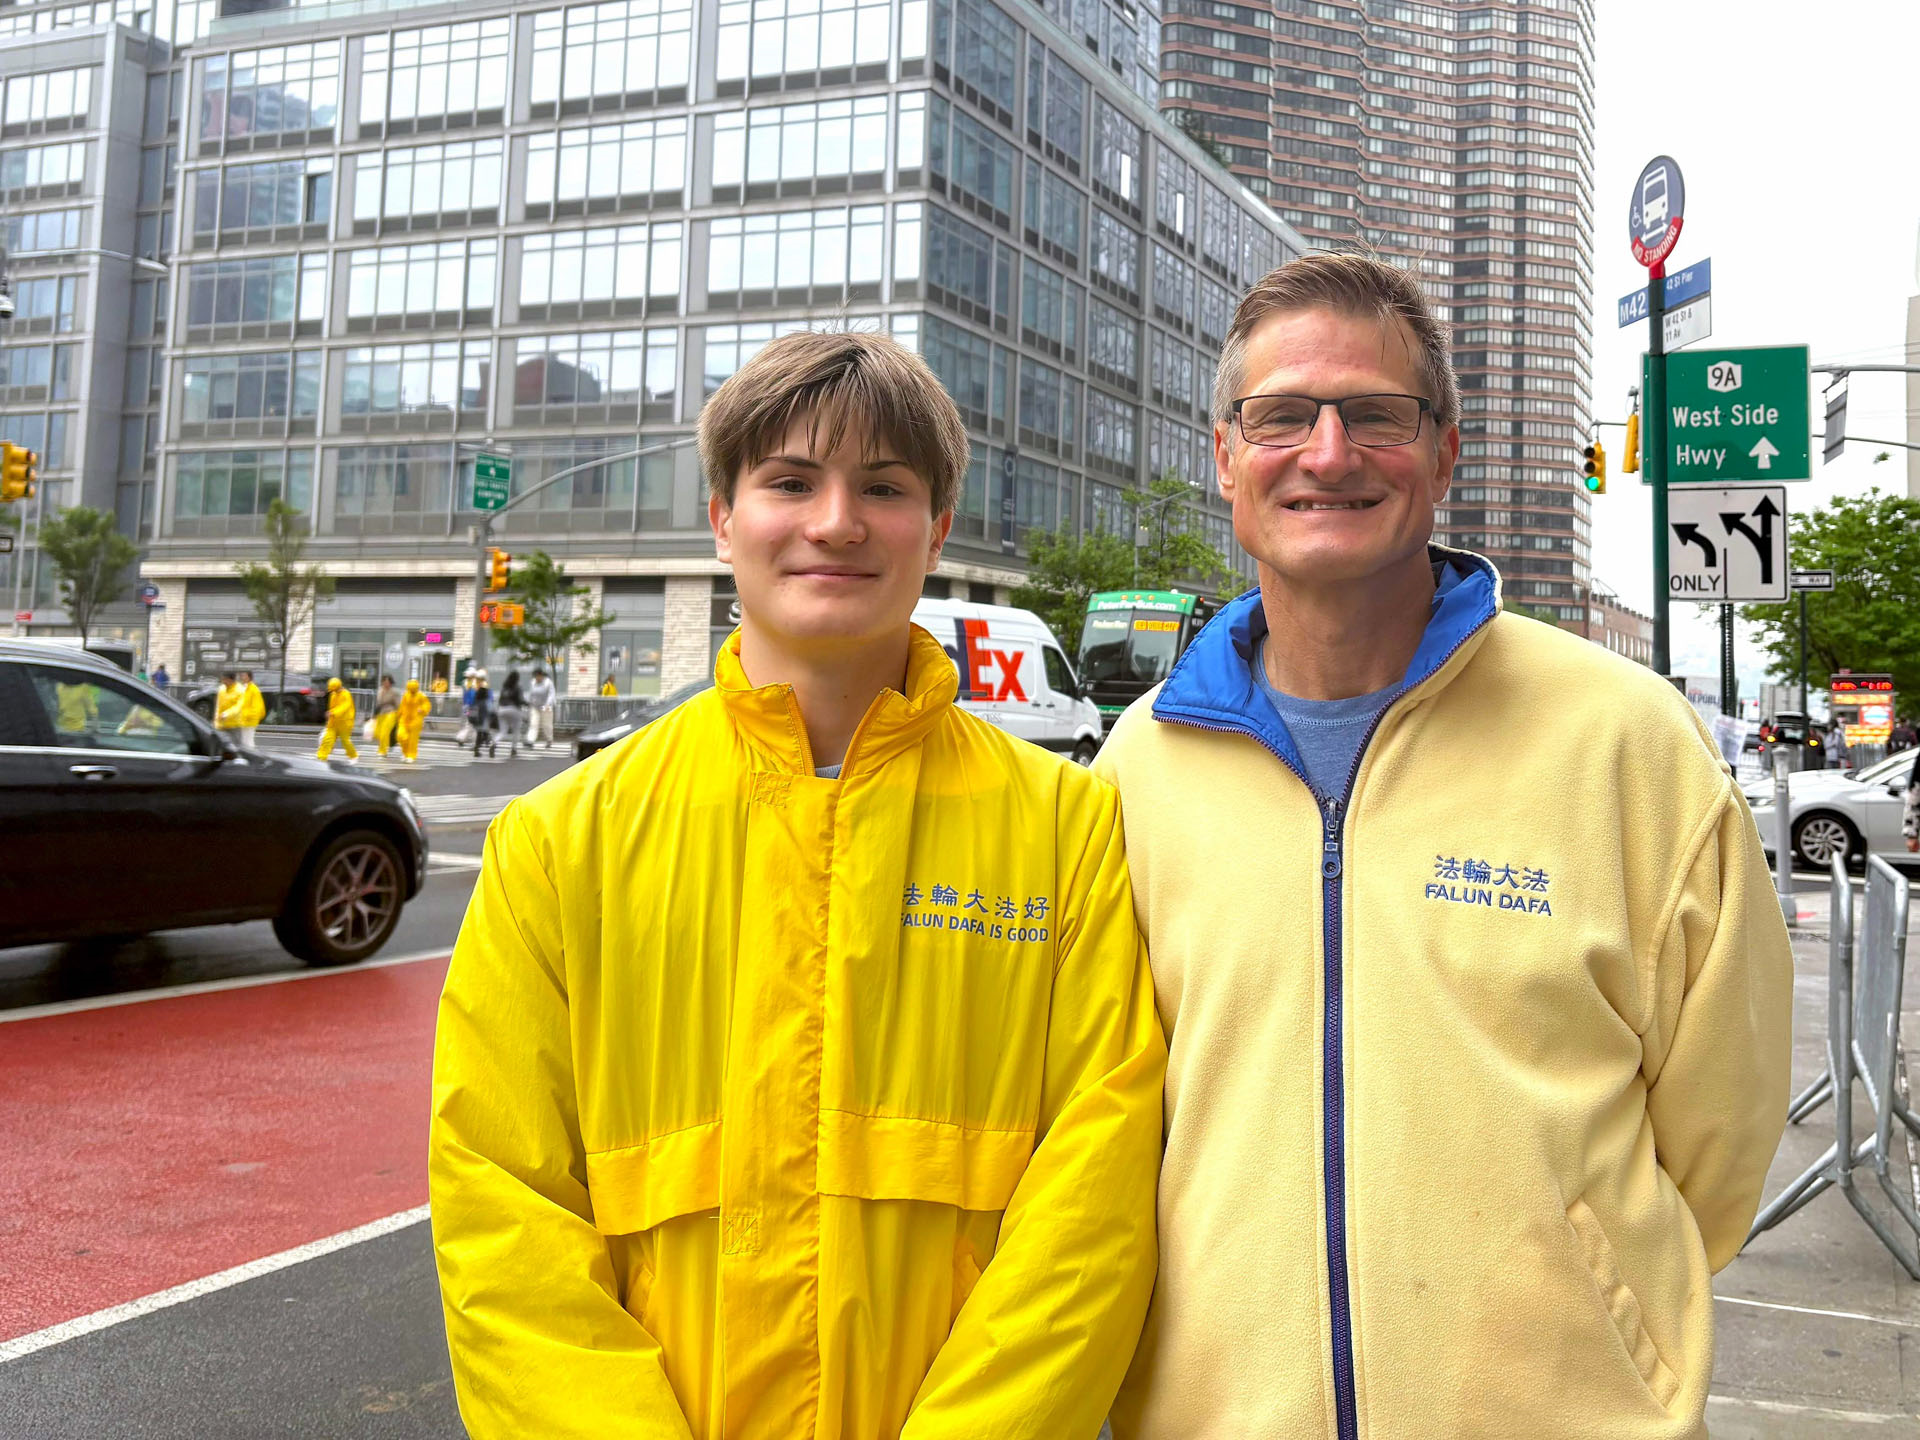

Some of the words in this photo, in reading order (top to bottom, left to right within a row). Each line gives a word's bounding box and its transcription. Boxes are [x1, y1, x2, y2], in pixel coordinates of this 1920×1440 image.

[1633, 244, 1643, 260] NO
[1644, 225, 1678, 263] STANDING
[1666, 279, 1673, 290] 42
[1674, 275, 1681, 288] St
[1681, 271, 1694, 284] Pier
[1619, 292, 1646, 324] M42
[1665, 316, 1671, 328] W
[1672, 313, 1679, 325] 42
[1680, 310, 1687, 323] St
[1665, 332, 1672, 342] 11
[1711, 367, 1737, 387] 9A
[1672, 406, 1721, 428] West
[1731, 404, 1779, 425] Side
[1676, 444, 1726, 470] Hwy
[1670, 574, 1721, 592] ONLY
[1808, 576, 1826, 584] WAY
[943, 617, 1029, 703] dEx
[1434, 854, 1550, 893] 法輪大法
[1425, 883, 1492, 906] FALUN
[1499, 893, 1552, 917] DAFA
[949, 916, 985, 936] DAFA
[989, 923, 1002, 939] IS
[1007, 928, 1049, 942] GOOD
